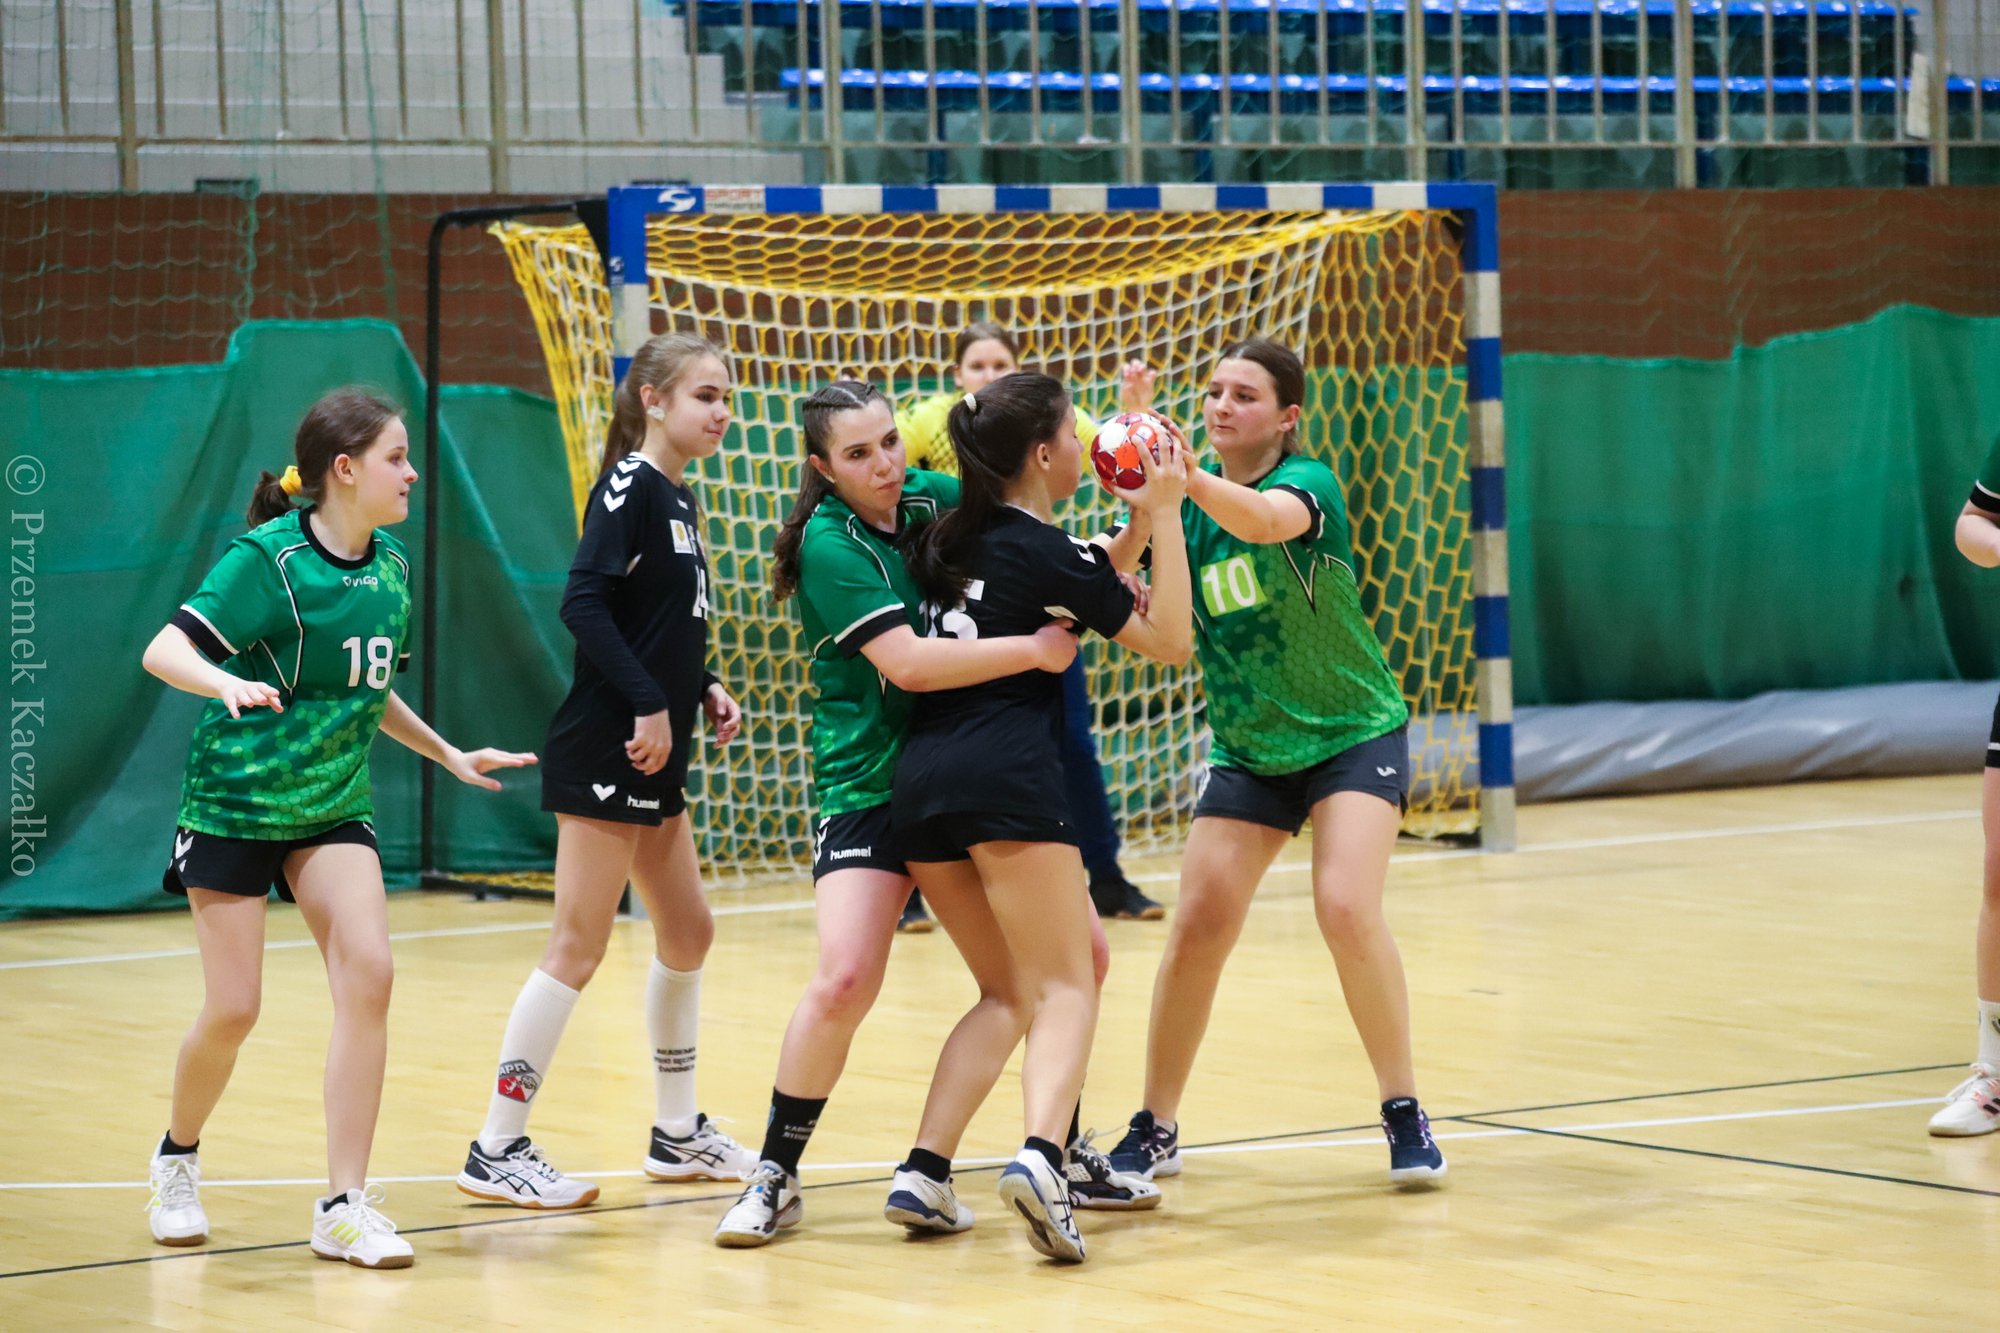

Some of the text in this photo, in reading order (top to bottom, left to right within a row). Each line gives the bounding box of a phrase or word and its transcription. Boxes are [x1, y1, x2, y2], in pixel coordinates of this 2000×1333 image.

[1203, 556, 1257, 613] 10
[342, 636, 394, 690] 18
[830, 846, 872, 861] hummel
